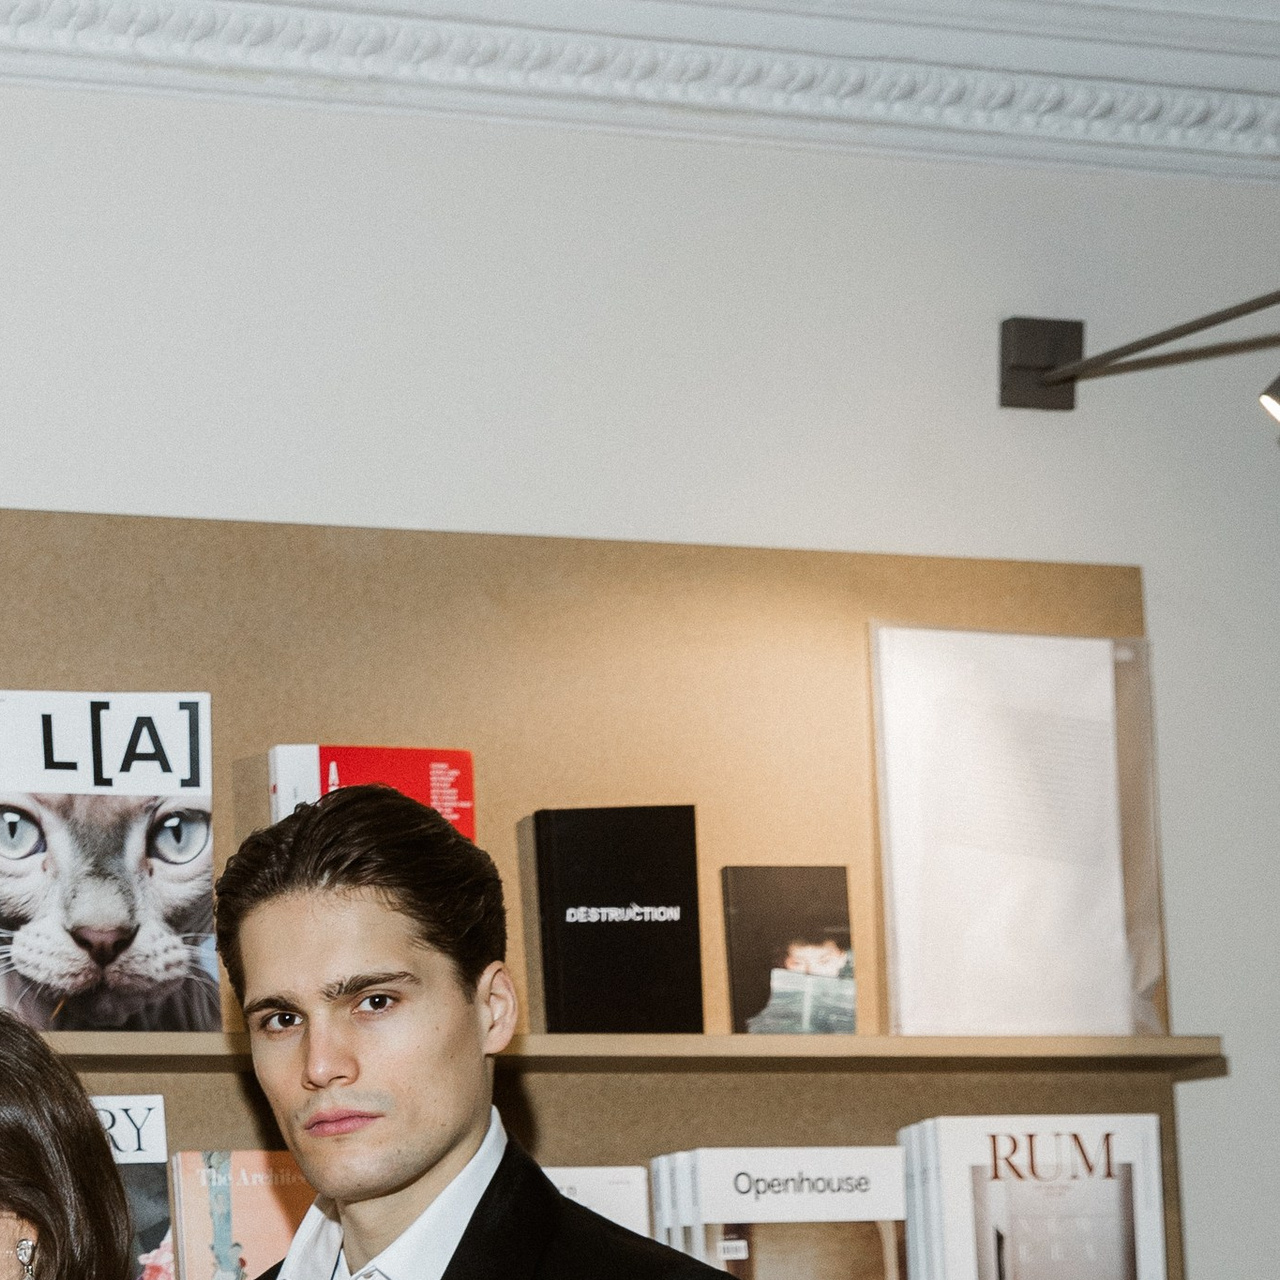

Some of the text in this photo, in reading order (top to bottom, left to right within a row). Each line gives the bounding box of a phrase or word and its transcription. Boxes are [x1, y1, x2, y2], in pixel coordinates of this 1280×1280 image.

[565, 902, 680, 922] DESTRUCTION
[987, 1132, 1116, 1181] RUM
[732, 1171, 871, 1200] Openhouse
